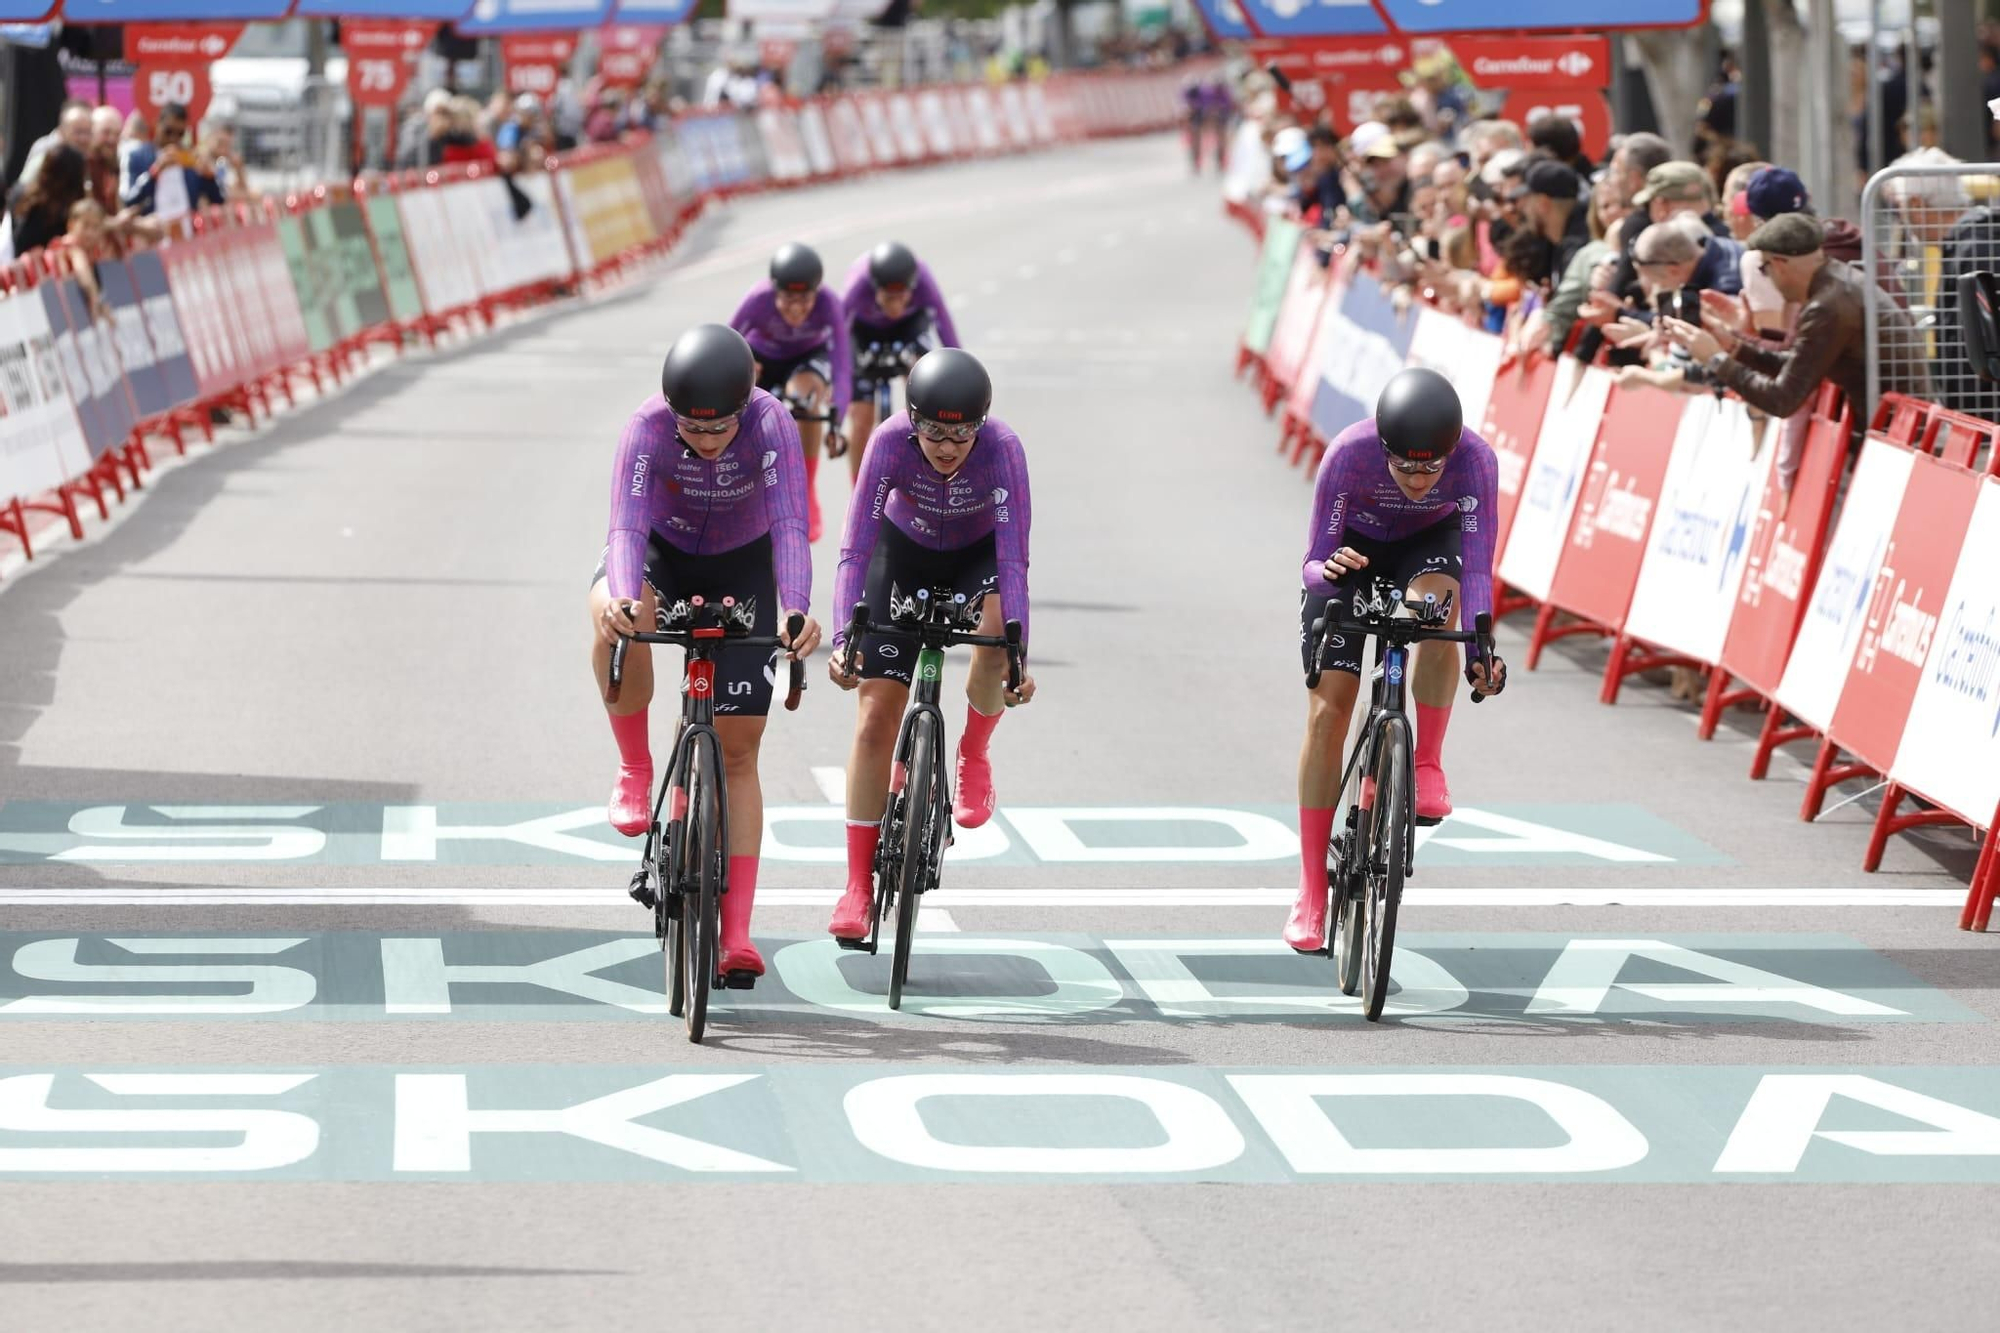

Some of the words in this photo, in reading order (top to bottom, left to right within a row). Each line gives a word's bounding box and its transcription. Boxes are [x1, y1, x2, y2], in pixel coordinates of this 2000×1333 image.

[357, 60, 395, 91] 75
[149, 71, 194, 106] 50
[715, 461, 739, 474] ISEO
[683, 481, 755, 498] BONGIOANNI
[949, 486, 973, 496] ISEO
